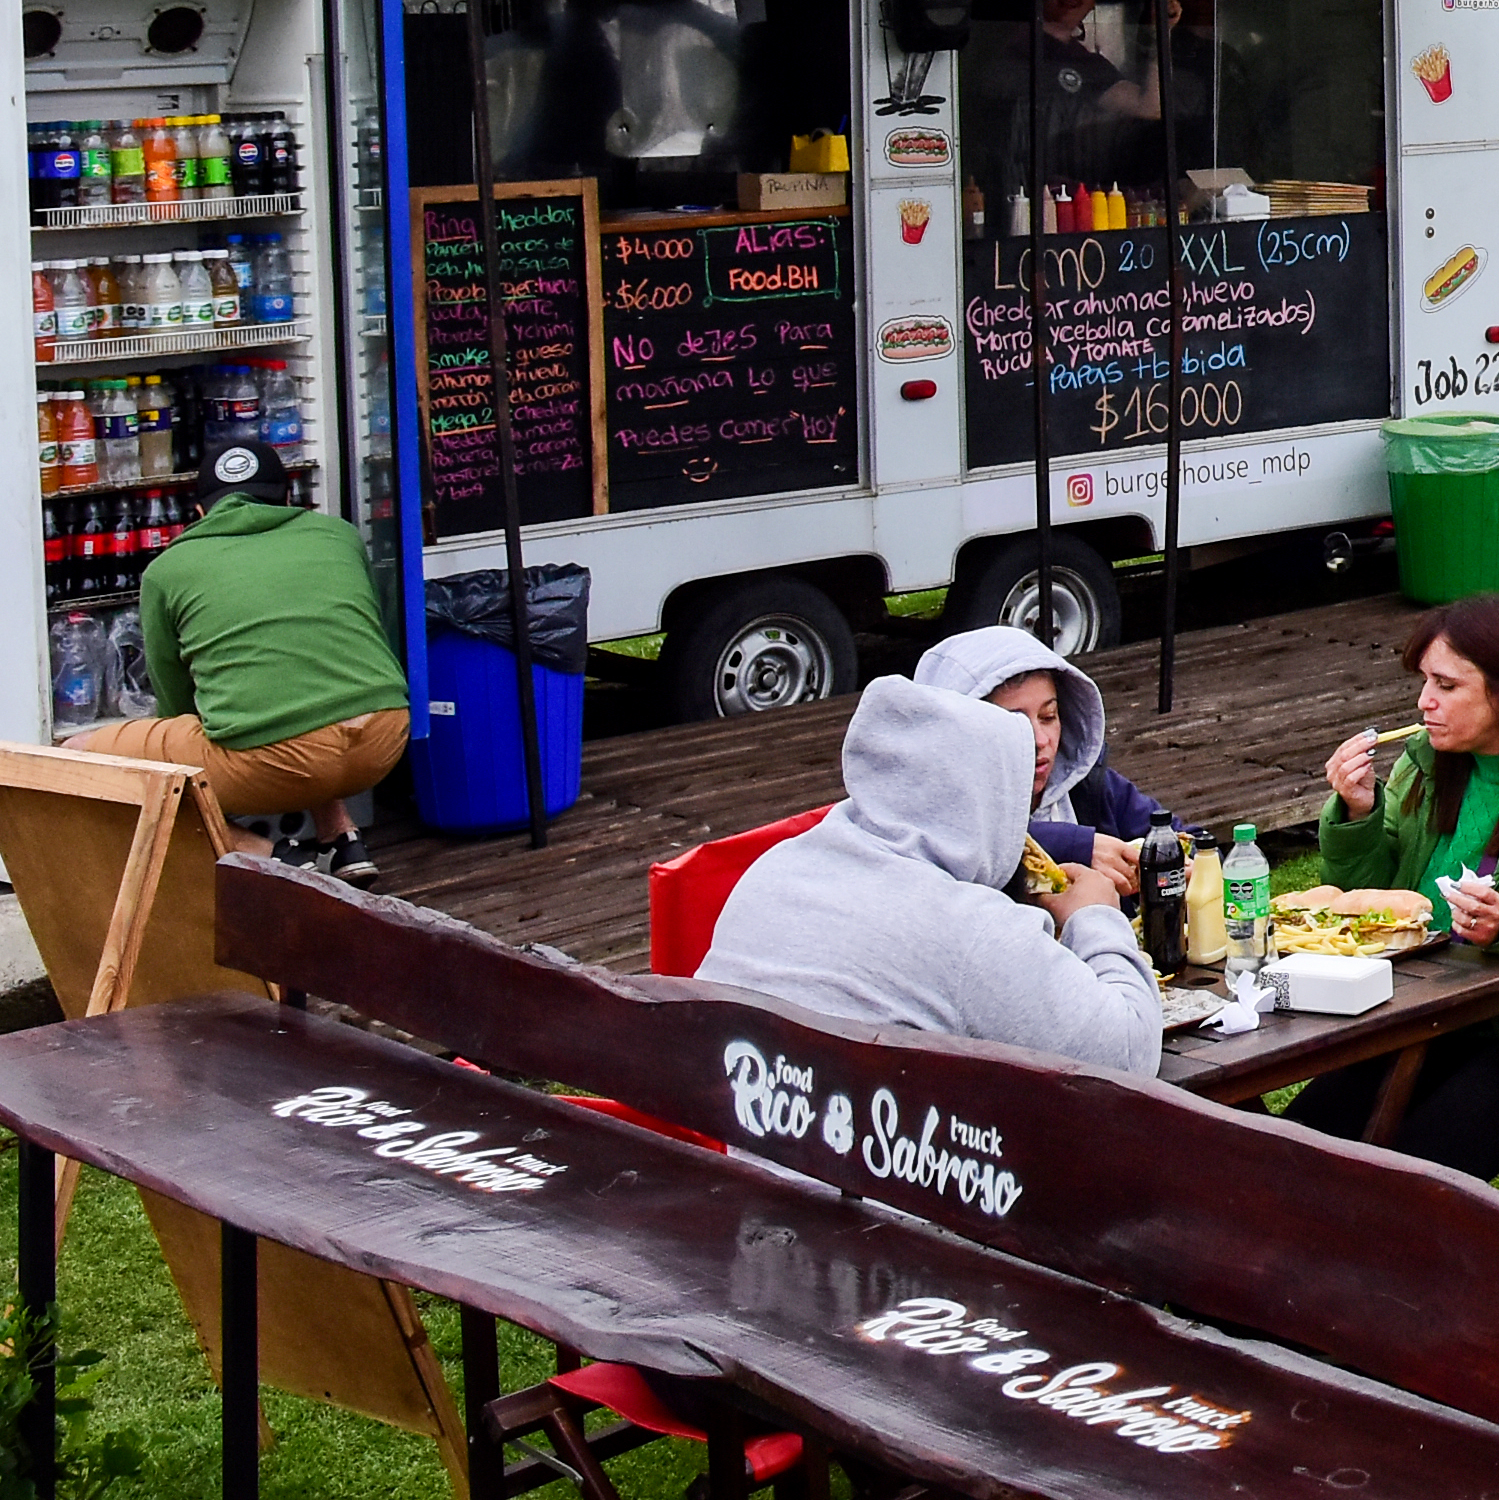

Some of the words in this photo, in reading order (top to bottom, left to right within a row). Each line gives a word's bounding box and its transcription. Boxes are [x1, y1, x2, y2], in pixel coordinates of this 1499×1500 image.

[1118, 240, 1155, 272] 2.0
[1179, 229, 1246, 278] XXL
[1257, 221, 1350, 274] (25cm)
[1414, 355, 1469, 406] Job
[772, 1054, 814, 1093] food
[271, 1086, 377, 1127] Rico
[373, 1130, 546, 1191] Sabroso
[723, 1040, 816, 1138] Rico
[823, 1094, 854, 1155] &
[862, 1087, 1023, 1216] Sabroso
[950, 1115, 1003, 1157] truck
[504, 1153, 569, 1175] truck
[860, 1297, 987, 1355] Rico
[962, 1316, 1029, 1342] food
[970, 1348, 1050, 1374] &
[1001, 1362, 1222, 1453] Sabroso
[1160, 1395, 1253, 1430] truck
